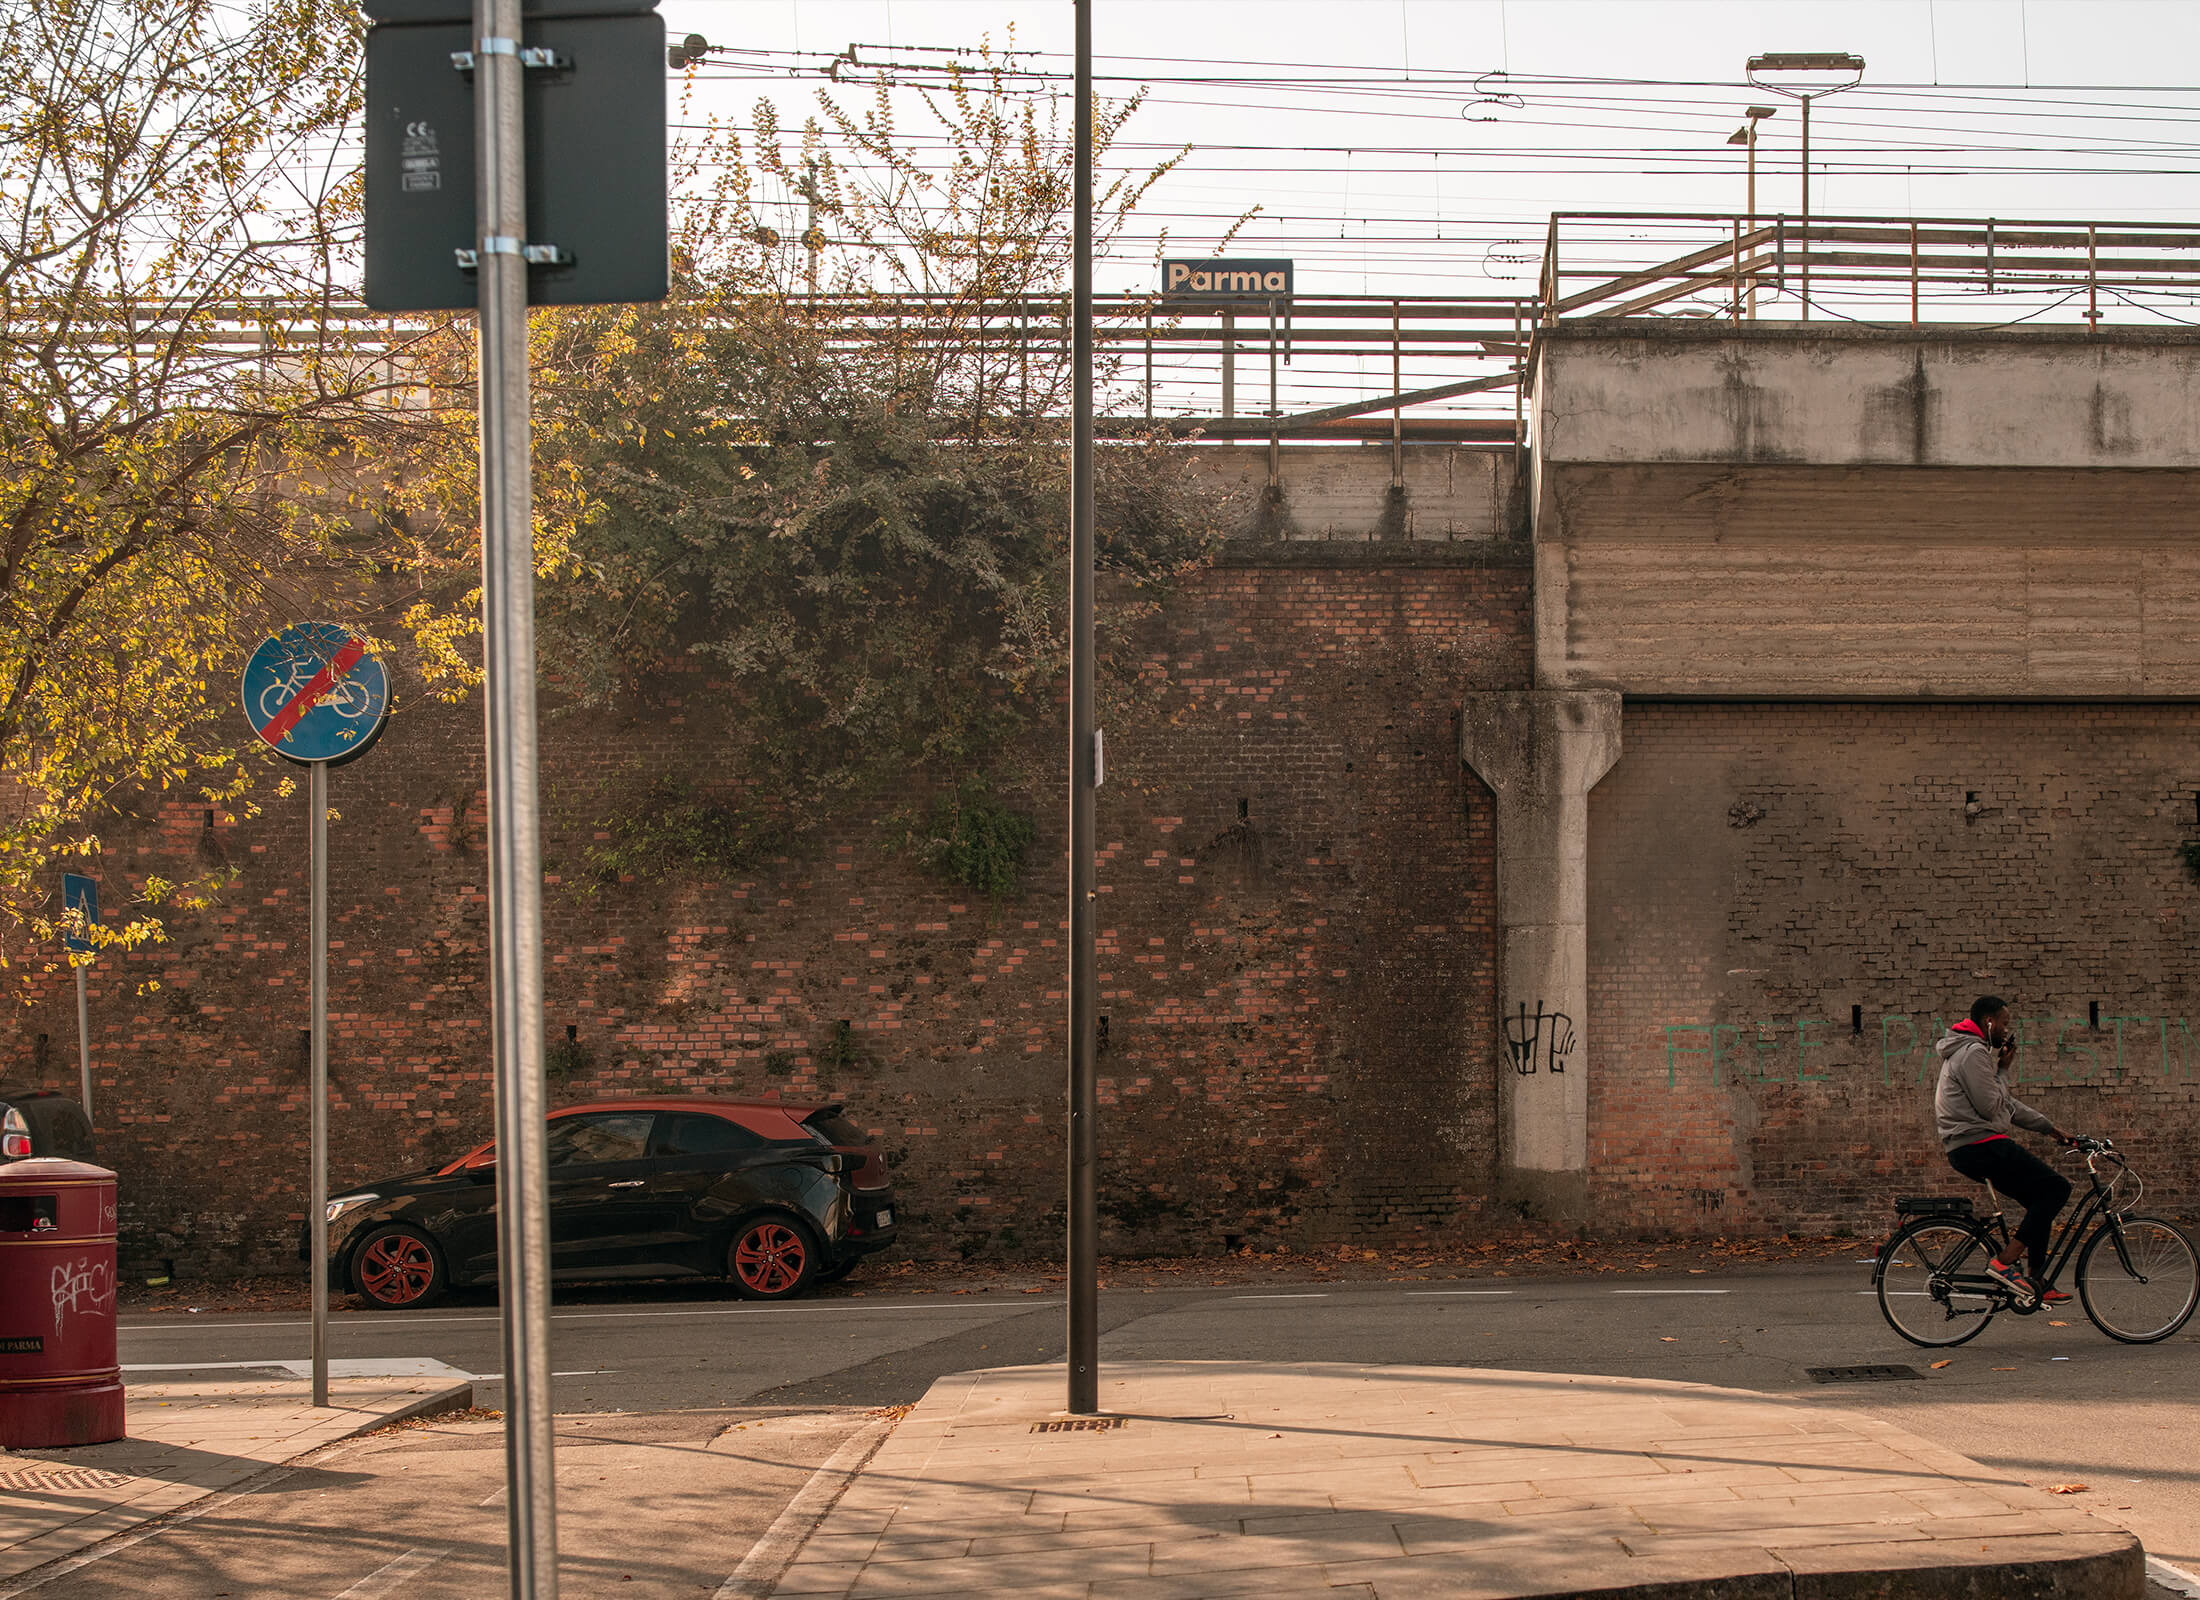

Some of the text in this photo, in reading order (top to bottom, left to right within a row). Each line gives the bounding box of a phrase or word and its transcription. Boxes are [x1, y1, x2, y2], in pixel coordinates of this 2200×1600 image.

[1168, 263, 1286, 291] Parma
[1665, 1015, 2200, 1089] FREE PAESTI
